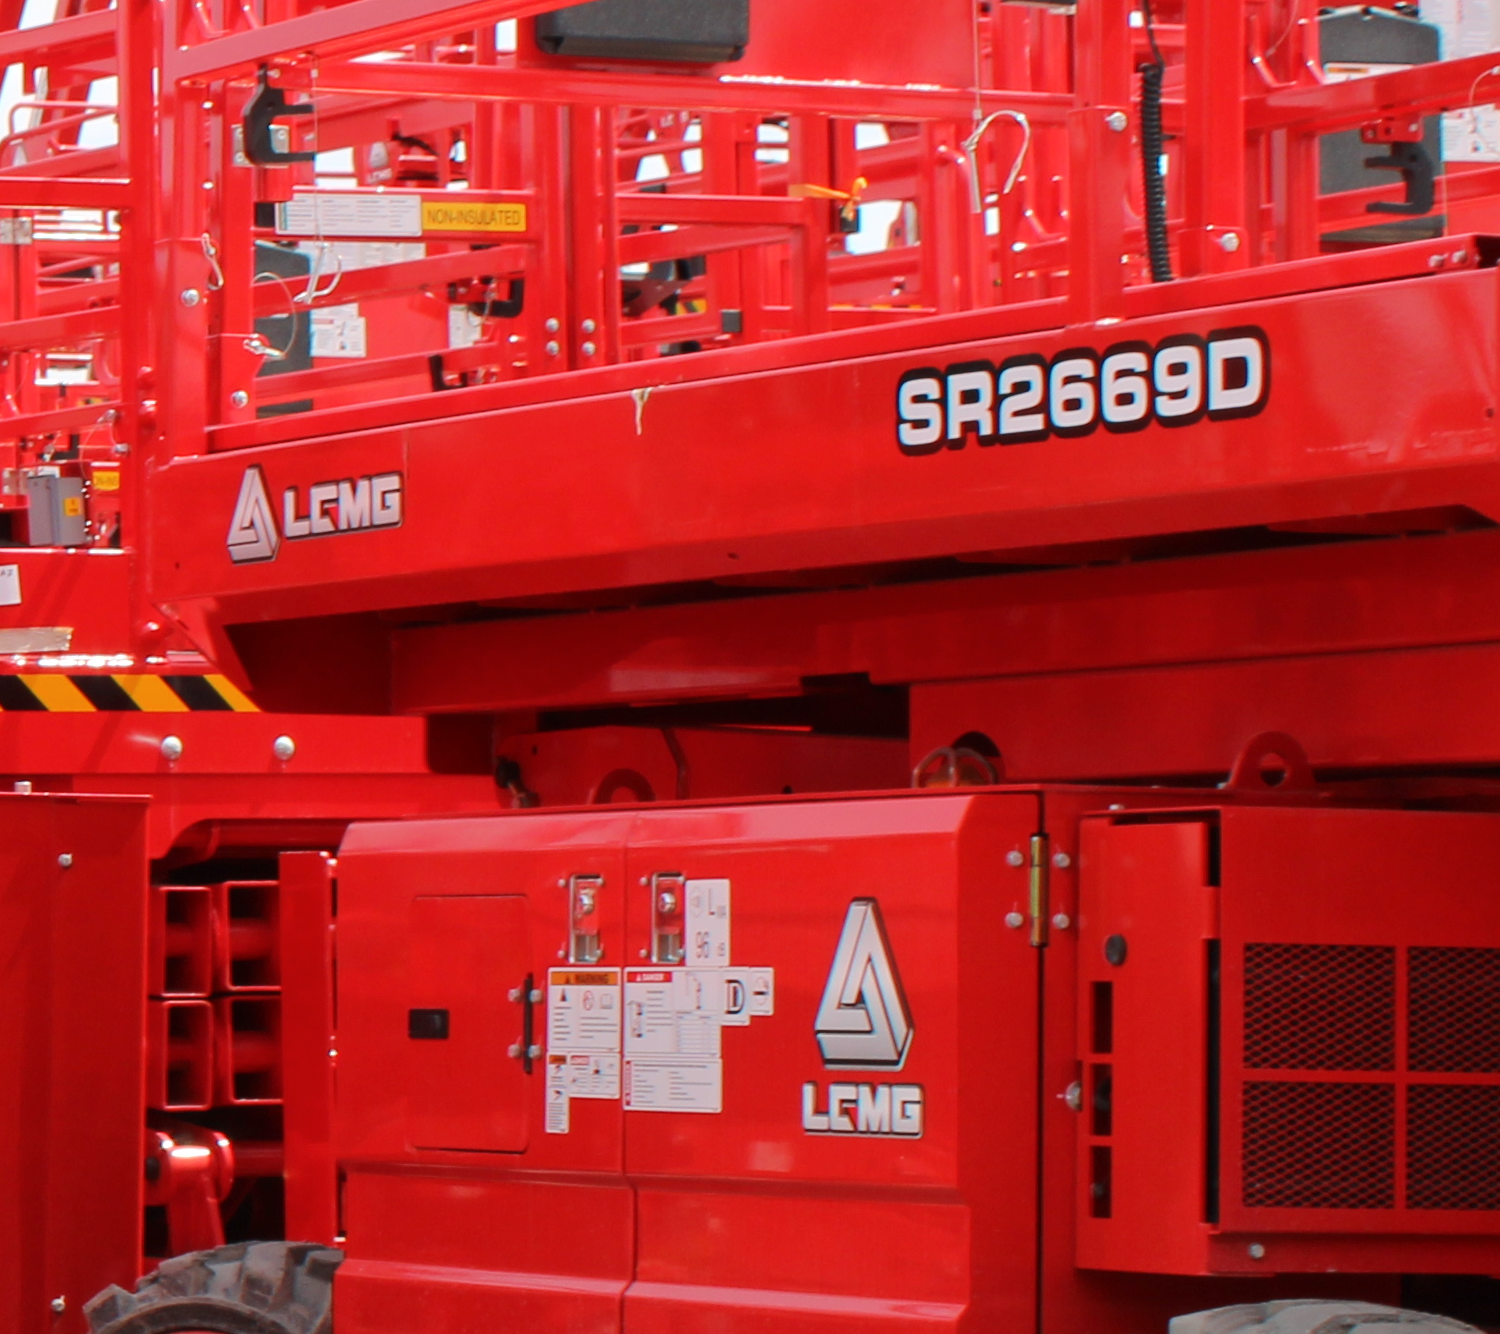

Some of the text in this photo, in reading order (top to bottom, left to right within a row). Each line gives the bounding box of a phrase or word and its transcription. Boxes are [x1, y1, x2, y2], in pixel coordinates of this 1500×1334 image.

[428, 209, 520, 225] NON-INSULATED
[899, 337, 1263, 445] SR2669D
[284, 473, 400, 538] LGMG
[803, 1082, 923, 1135] LGMG
